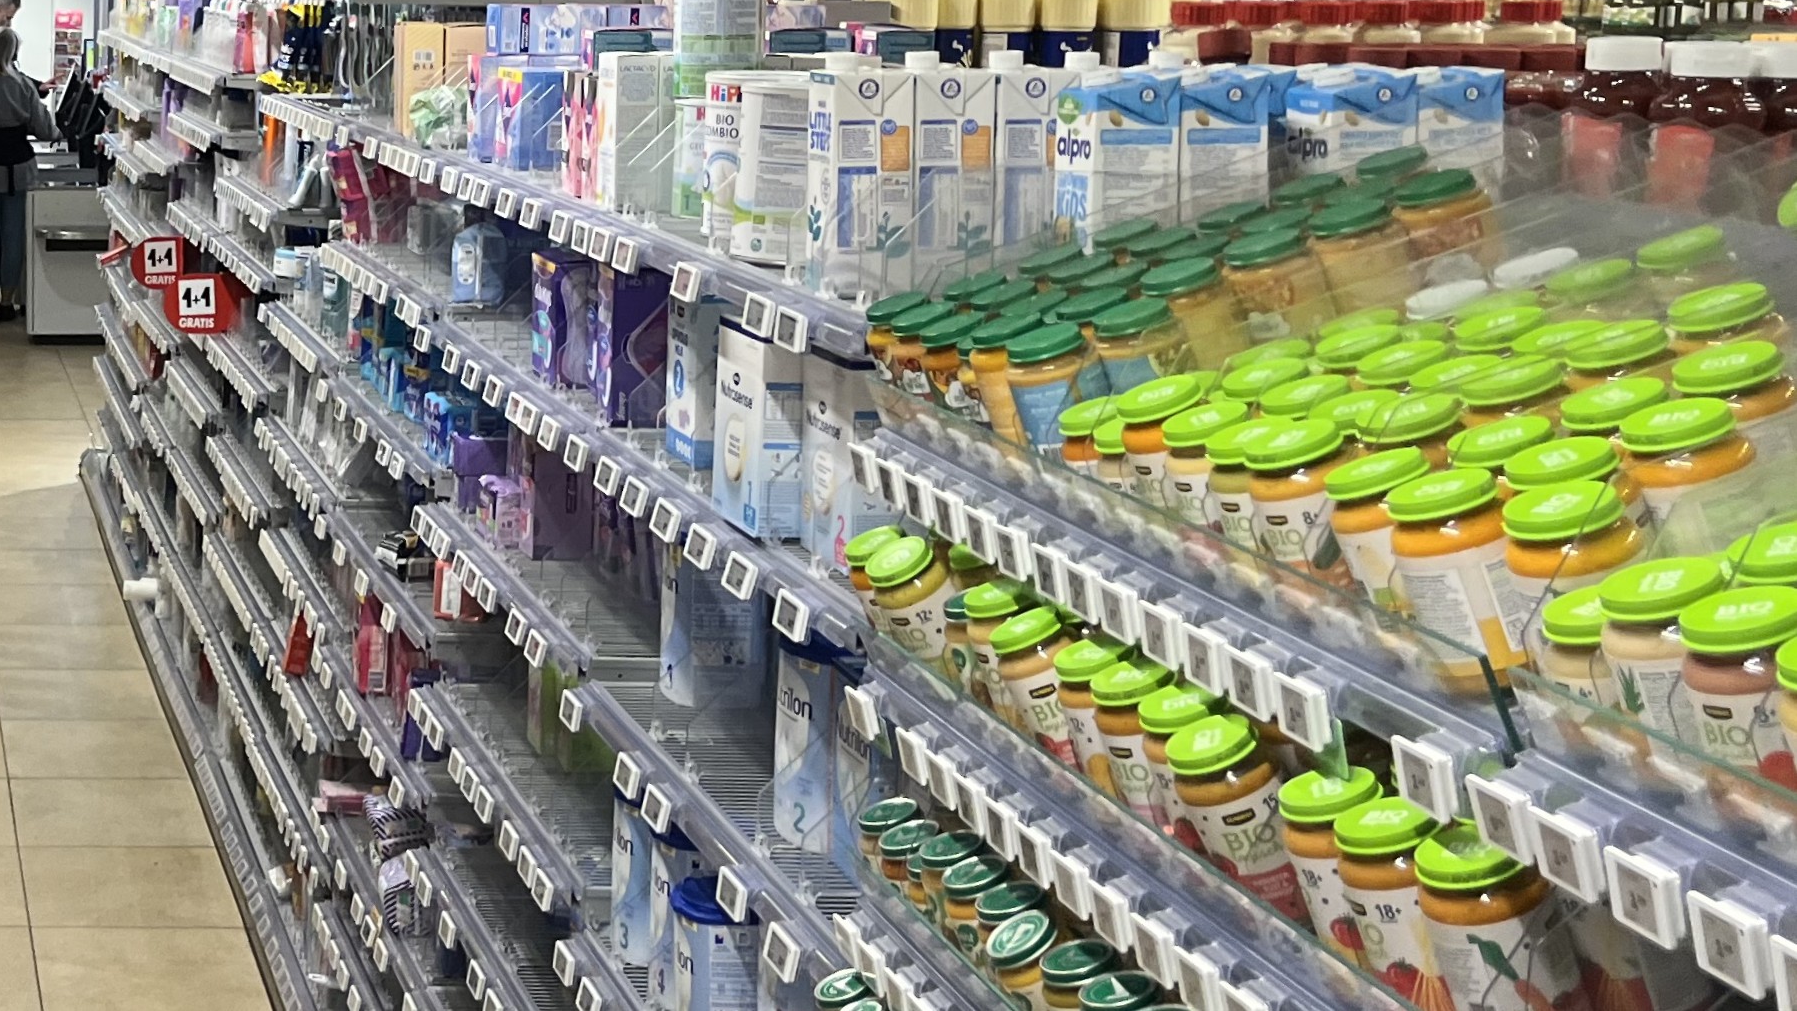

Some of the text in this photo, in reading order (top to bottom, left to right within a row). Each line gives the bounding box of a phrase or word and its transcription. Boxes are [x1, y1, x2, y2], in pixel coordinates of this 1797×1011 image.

[715, 114, 735, 126] BIO
[1057, 128, 1092, 165] alpro
[147, 247, 173, 268] 1+1
[144, 274, 176, 286] GRATIS
[182, 286, 211, 309] 1+1
[178, 317, 215, 329] GRATIS
[1704, 722, 1750, 747] BIO
[1223, 824, 1277, 857] BIO
[1375, 903, 1403, 922] 18+
